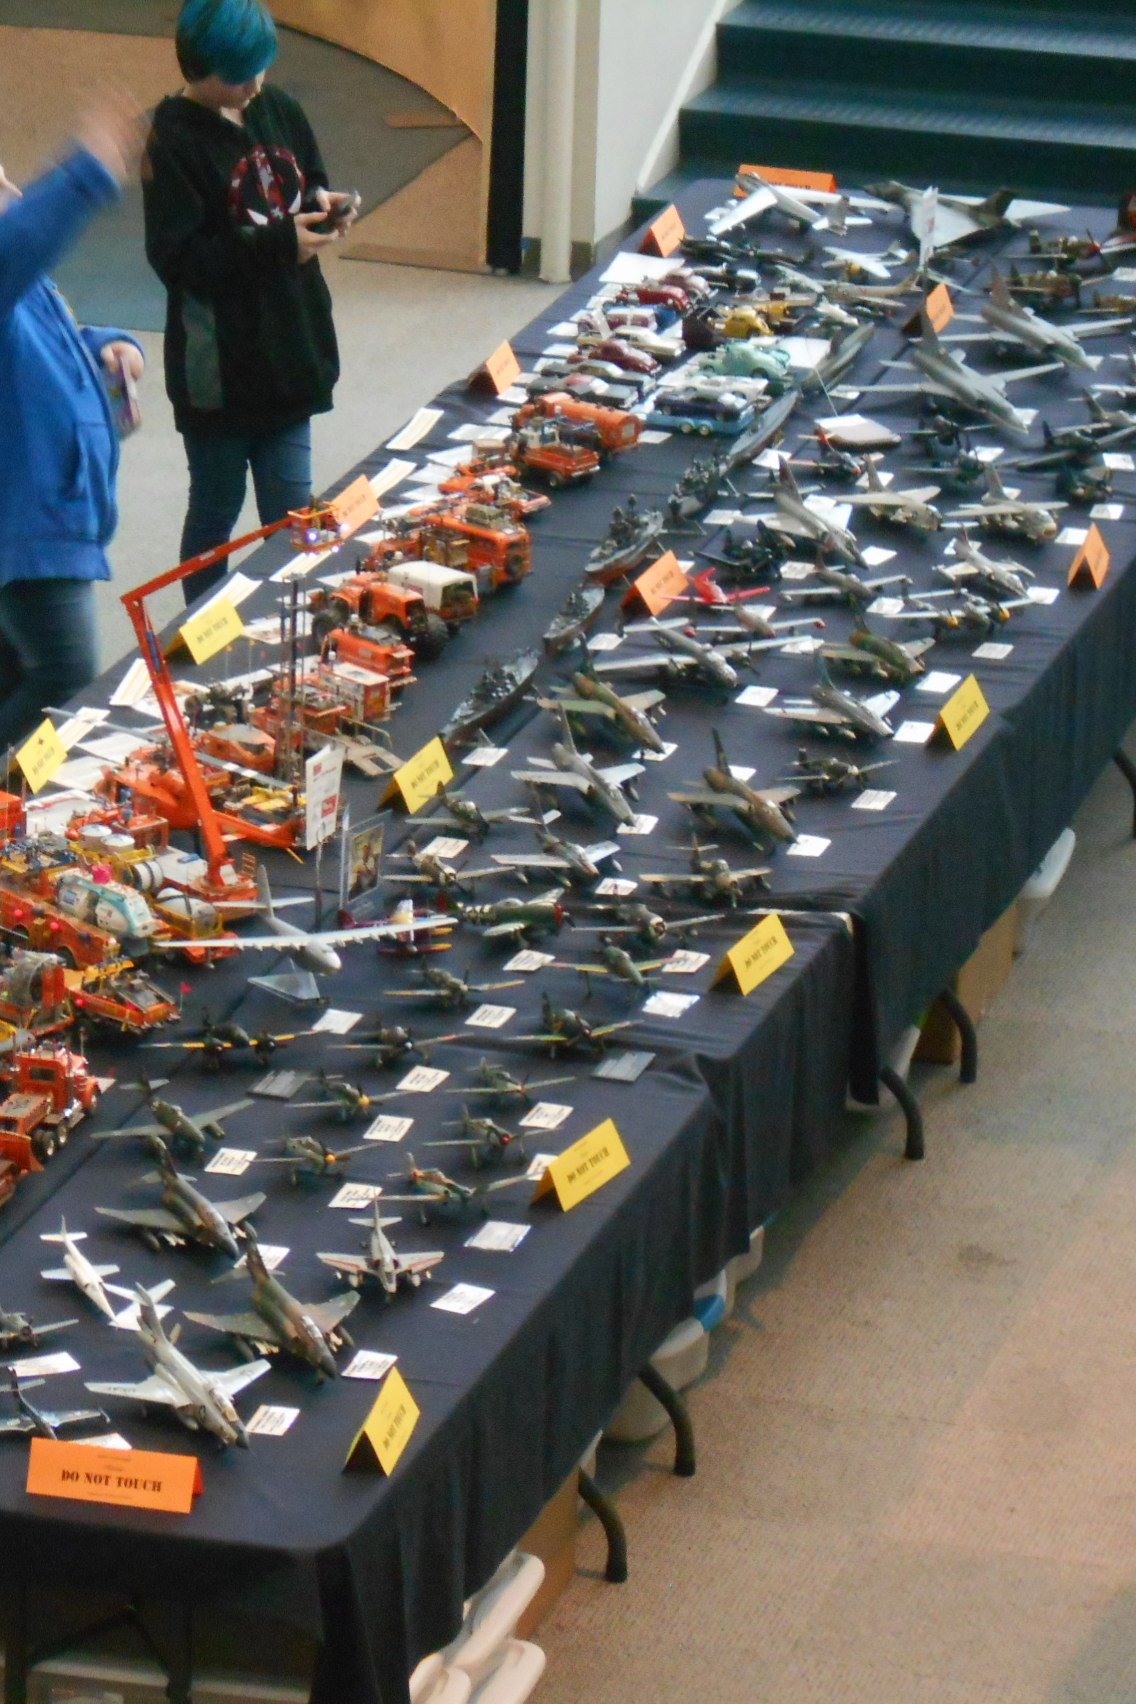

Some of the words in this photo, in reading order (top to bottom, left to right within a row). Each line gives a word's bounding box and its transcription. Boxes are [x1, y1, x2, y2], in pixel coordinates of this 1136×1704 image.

[745, 959, 752, 969] DO
[752, 949, 763, 961] NOT
[761, 936, 778, 953] TOUCH
[567, 1172, 576, 1184] DO
[576, 1163, 590, 1178] NOT
[589, 1146, 610, 1171] TOUCH
[60, 1469, 80, 1484] DO
[84, 1472, 112, 1488] NOT
[114, 1476, 162, 1493] TOUCH
